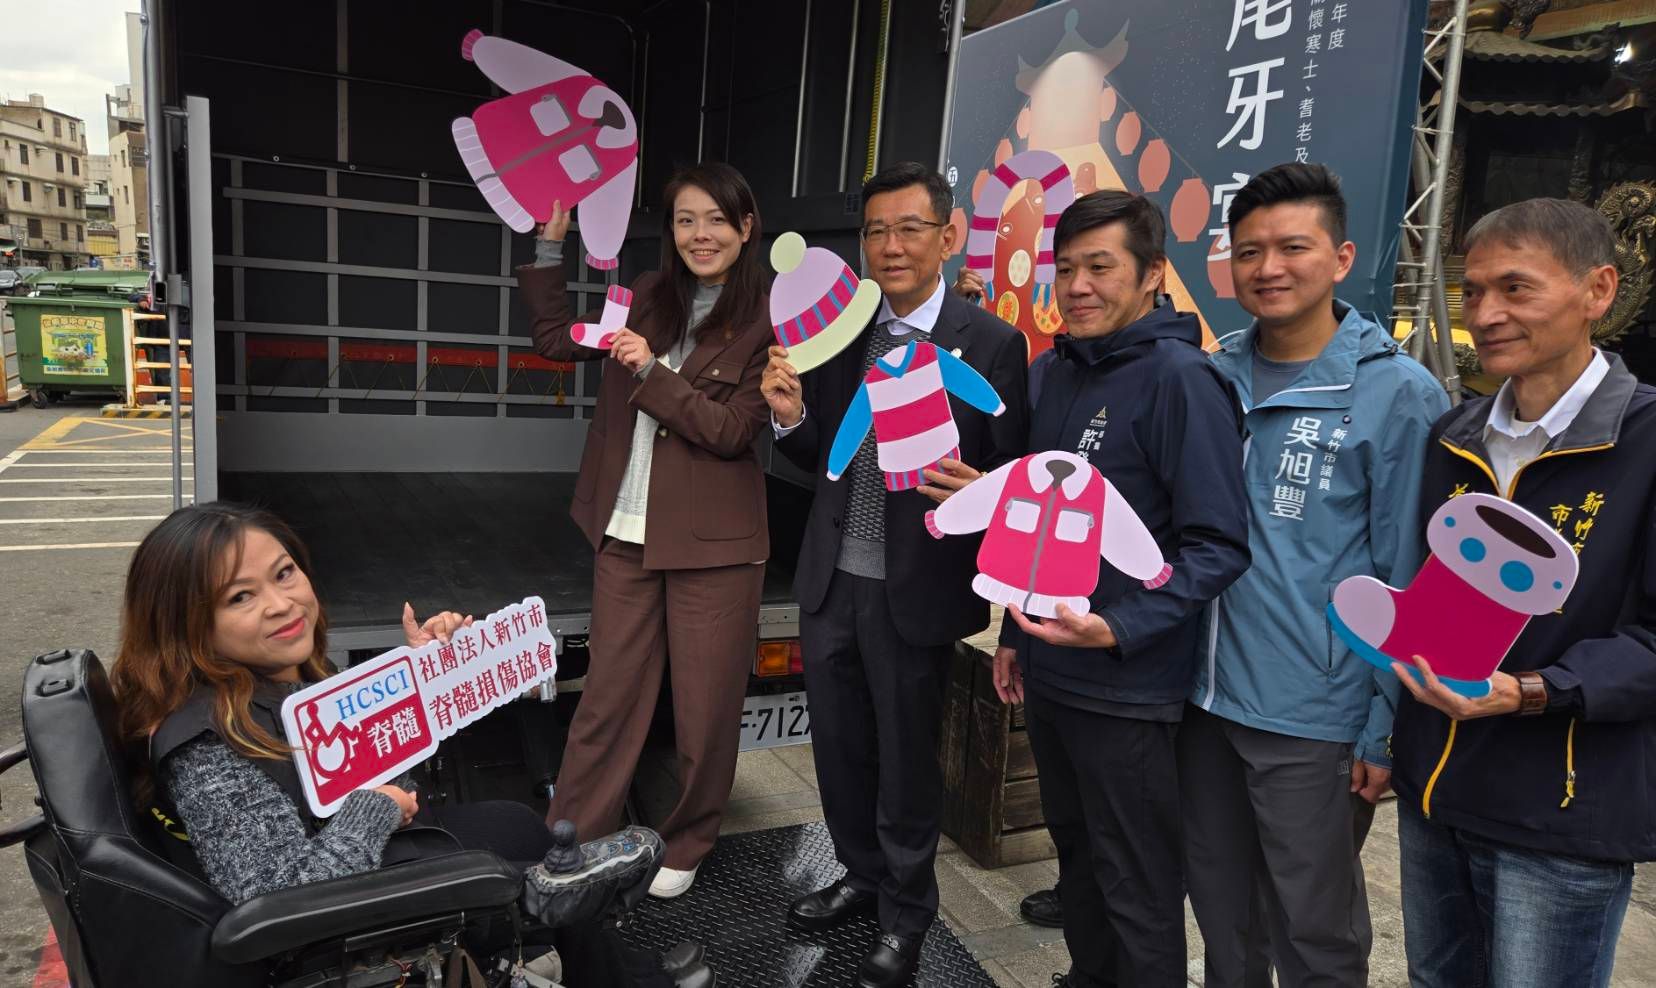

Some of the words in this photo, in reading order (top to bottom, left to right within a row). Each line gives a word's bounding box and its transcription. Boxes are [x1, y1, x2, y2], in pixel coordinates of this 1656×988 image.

[1295, 0, 1326, 164] 懷寒士、耆老及
[1269, 416, 1322, 521] 吳旭豐
[1318, 428, 1348, 491] 新竹市議員
[419, 603, 545, 684] 社團法人新竹市
[335, 669, 410, 721] HCSCI
[429, 641, 553, 731] 脊髓損傷協會
[367, 706, 422, 758] 脊髓
